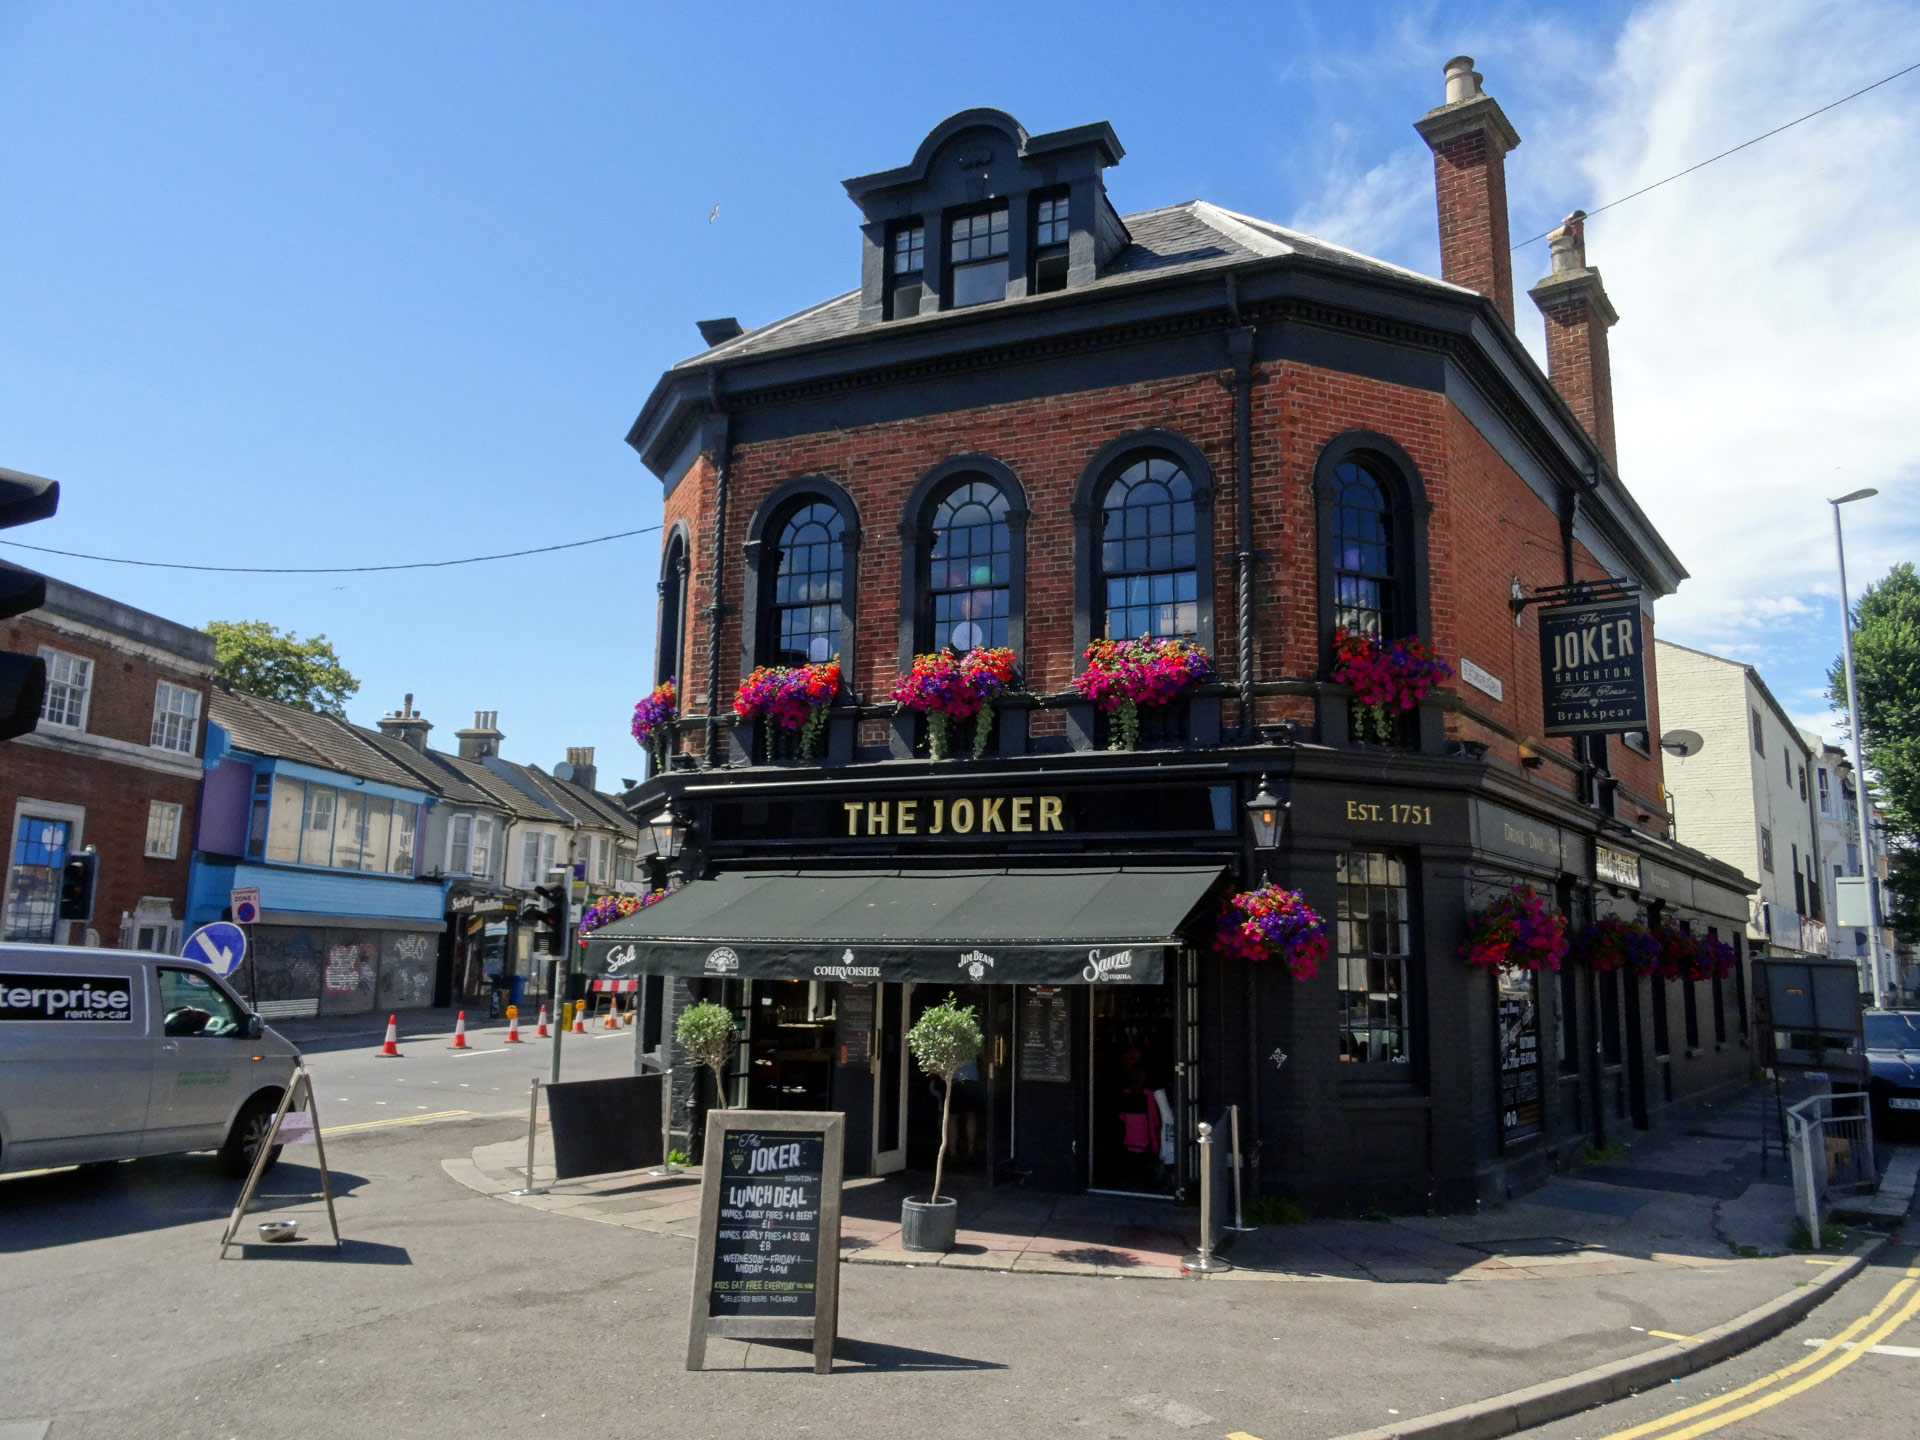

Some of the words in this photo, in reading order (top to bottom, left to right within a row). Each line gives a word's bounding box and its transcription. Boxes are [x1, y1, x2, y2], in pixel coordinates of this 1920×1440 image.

[1578, 612, 1600, 625] The
[1552, 619, 1634, 672] JOKER
[1555, 667, 1631, 682] BRIGHTON
[1560, 687, 1592, 699] Public
[1596, 685, 1627, 696] House
[1557, 708, 1632, 720] Brakspear
[843, 800, 918, 835] THE
[929, 796, 1064, 834] JOKER
[1346, 800, 1383, 821] EST.
[1390, 804, 1432, 825] 1751
[606, 944, 637, 972] Stoli
[709, 949, 735, 964] BRUGAL
[958, 953, 972, 968] JIM
[972, 950, 994, 968] BEAM
[813, 965, 880, 979] COURVOISIER
[1083, 949, 1132, 982] Sauza
[64, 1009, 128, 1019] rent-a-car
[738, 1134, 761, 1147] The
[748, 1143, 800, 1174] JOKER
[729, 1185, 773, 1208] LUNCH
[773, 1186, 807, 1208] DEAL
[745, 1209, 764, 1219] CURLY
[765, 1210, 783, 1220] FRIES
[742, 1230, 764, 1240] CURLY
[759, 1241, 771, 1251] £8
[714, 1281, 730, 1289] KIDS
[731, 1281, 743, 1290] EAT
[745, 1281, 762, 1290] FREE
[764, 1281, 796, 1291] EVERYDAY
[751, 1295, 767, 1303] BEERS
